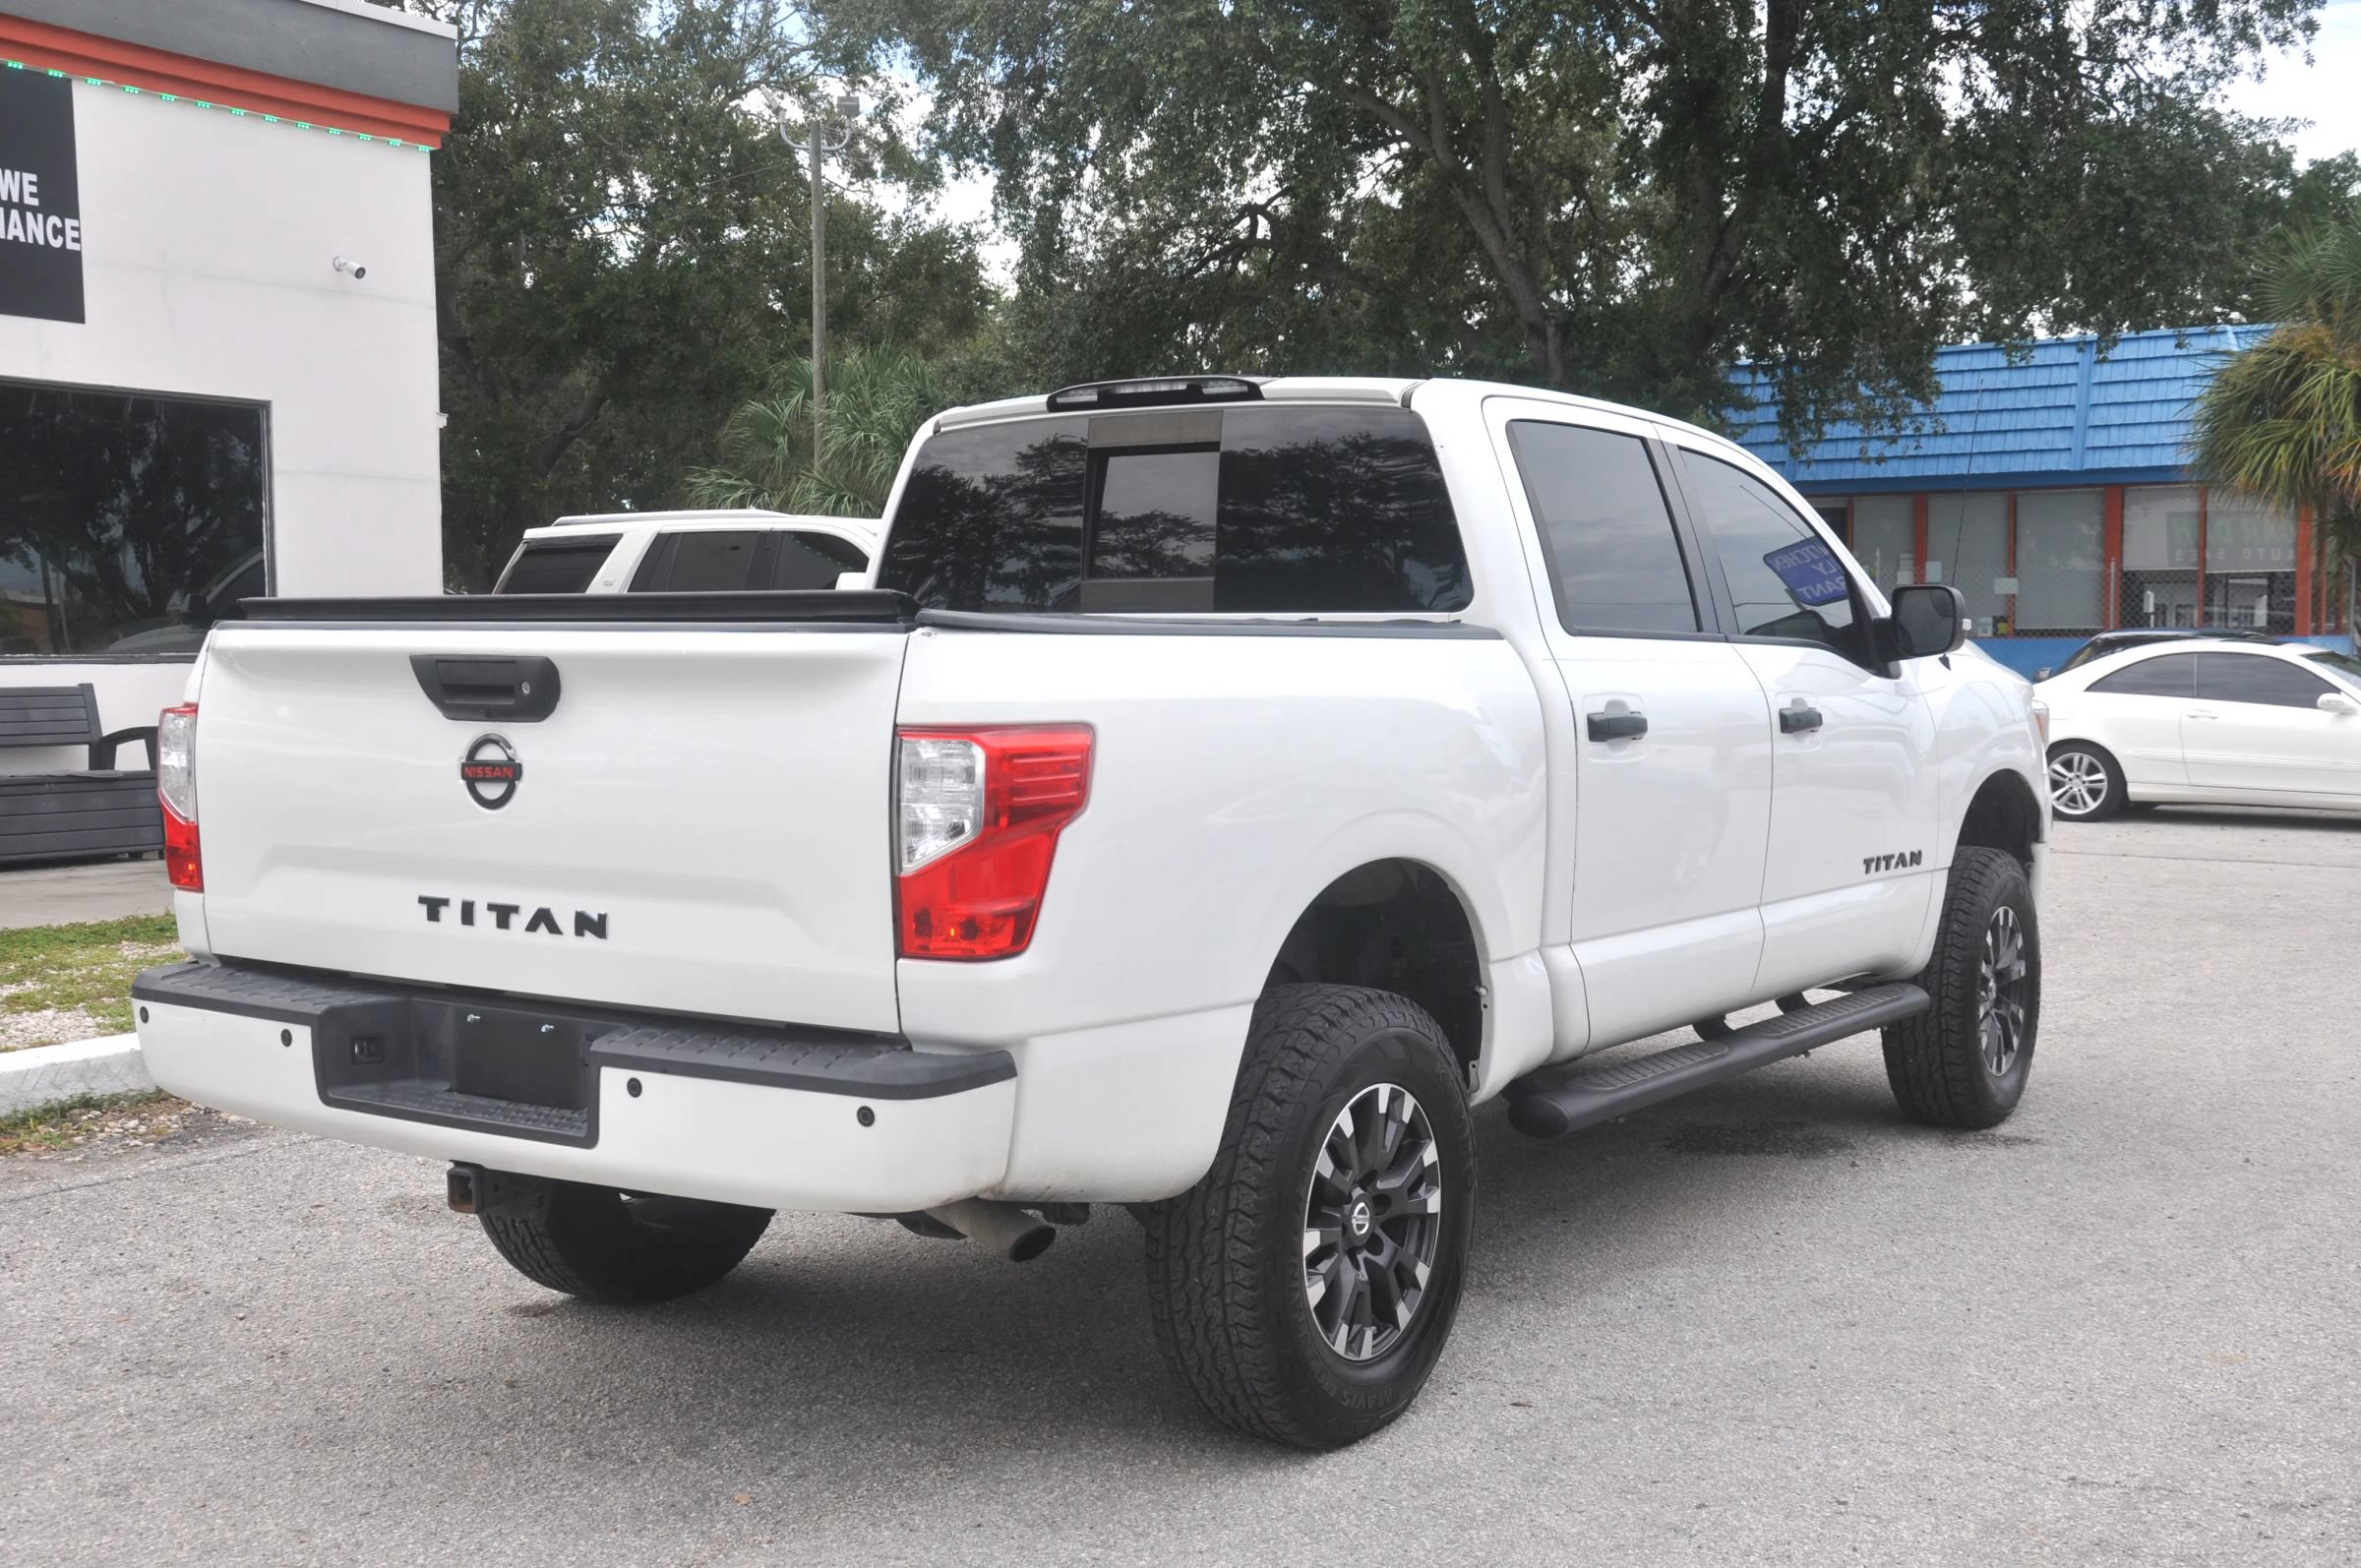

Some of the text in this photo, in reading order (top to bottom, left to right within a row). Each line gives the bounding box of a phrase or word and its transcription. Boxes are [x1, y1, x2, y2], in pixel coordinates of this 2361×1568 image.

[0, 168, 39, 207] WE
[0, 207, 81, 251] ANCE
[463, 765, 514, 779] NISSAN
[1863, 850, 1922, 874] TITAN
[417, 894, 609, 940] TITAN
